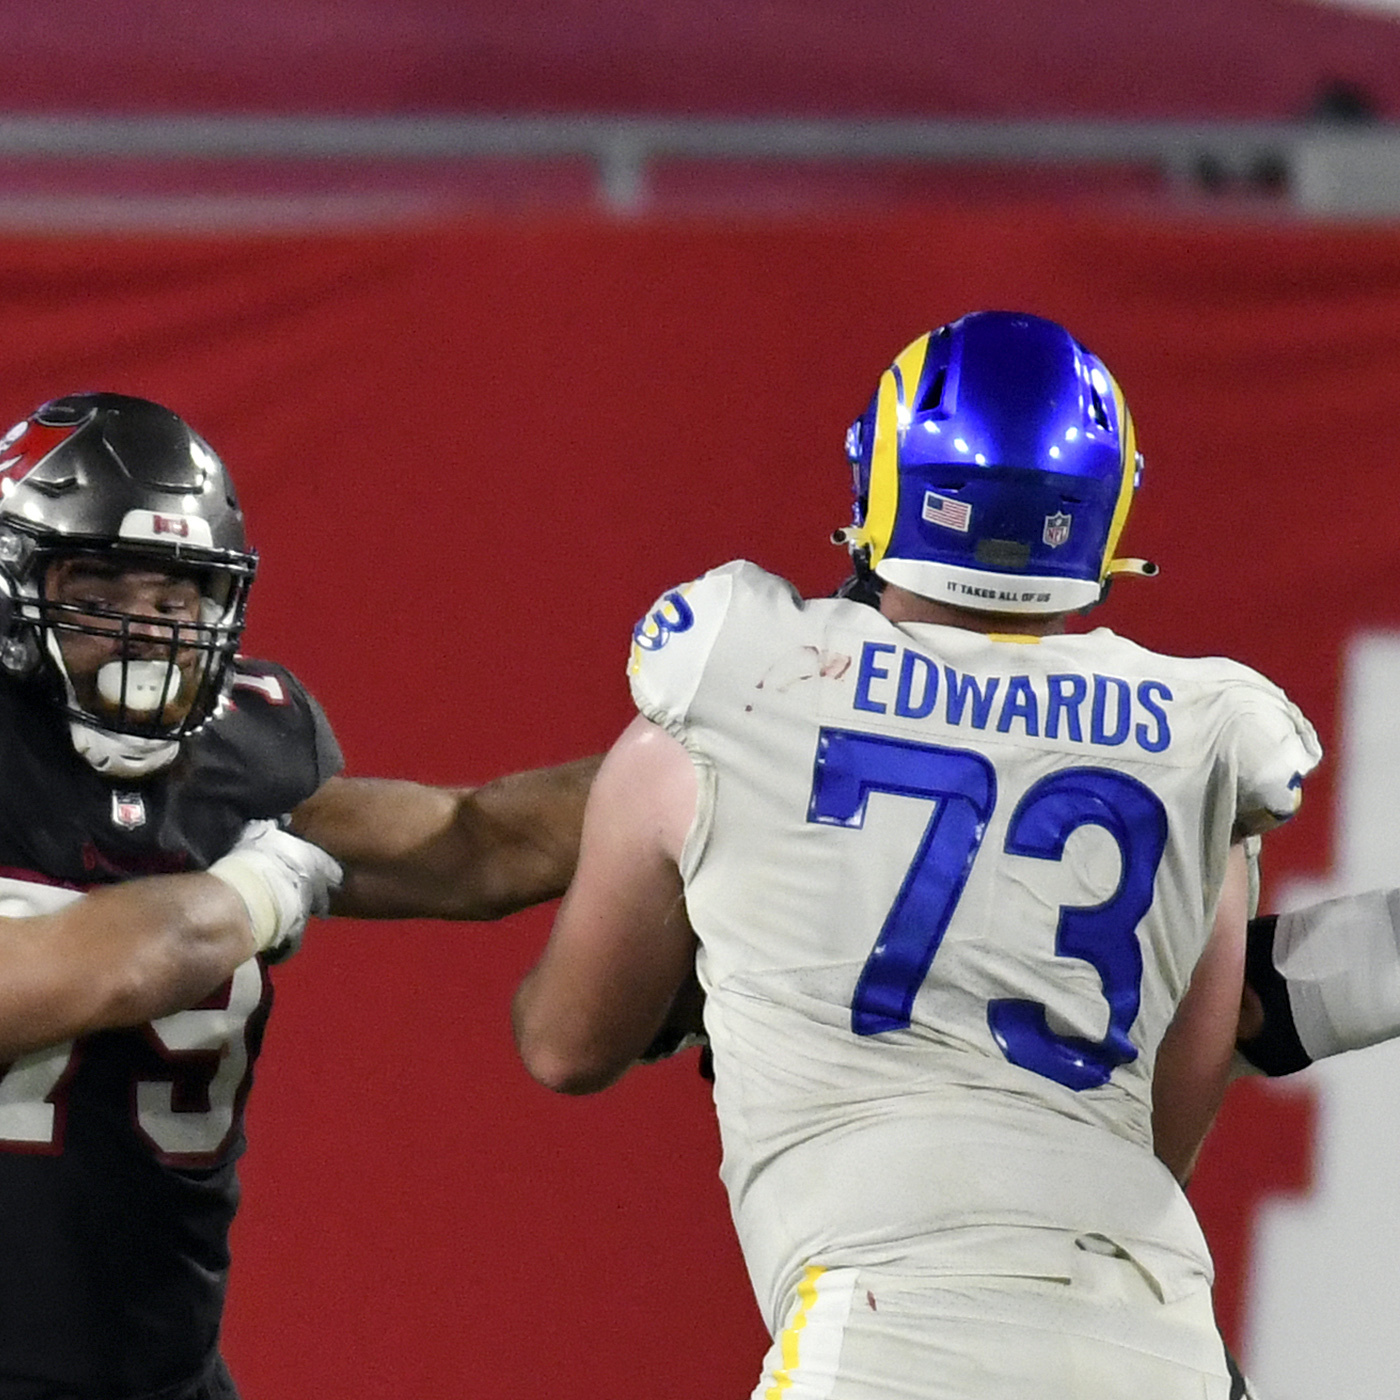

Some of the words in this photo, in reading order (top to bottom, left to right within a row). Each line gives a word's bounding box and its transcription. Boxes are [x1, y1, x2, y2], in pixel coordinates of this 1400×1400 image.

[947, 581, 958, 592] IT
[960, 583, 996, 600] TAKES
[998, 591, 1018, 603] ALL
[853, 641, 1174, 754] EDWARDS
[806, 726, 1169, 1092] 73
